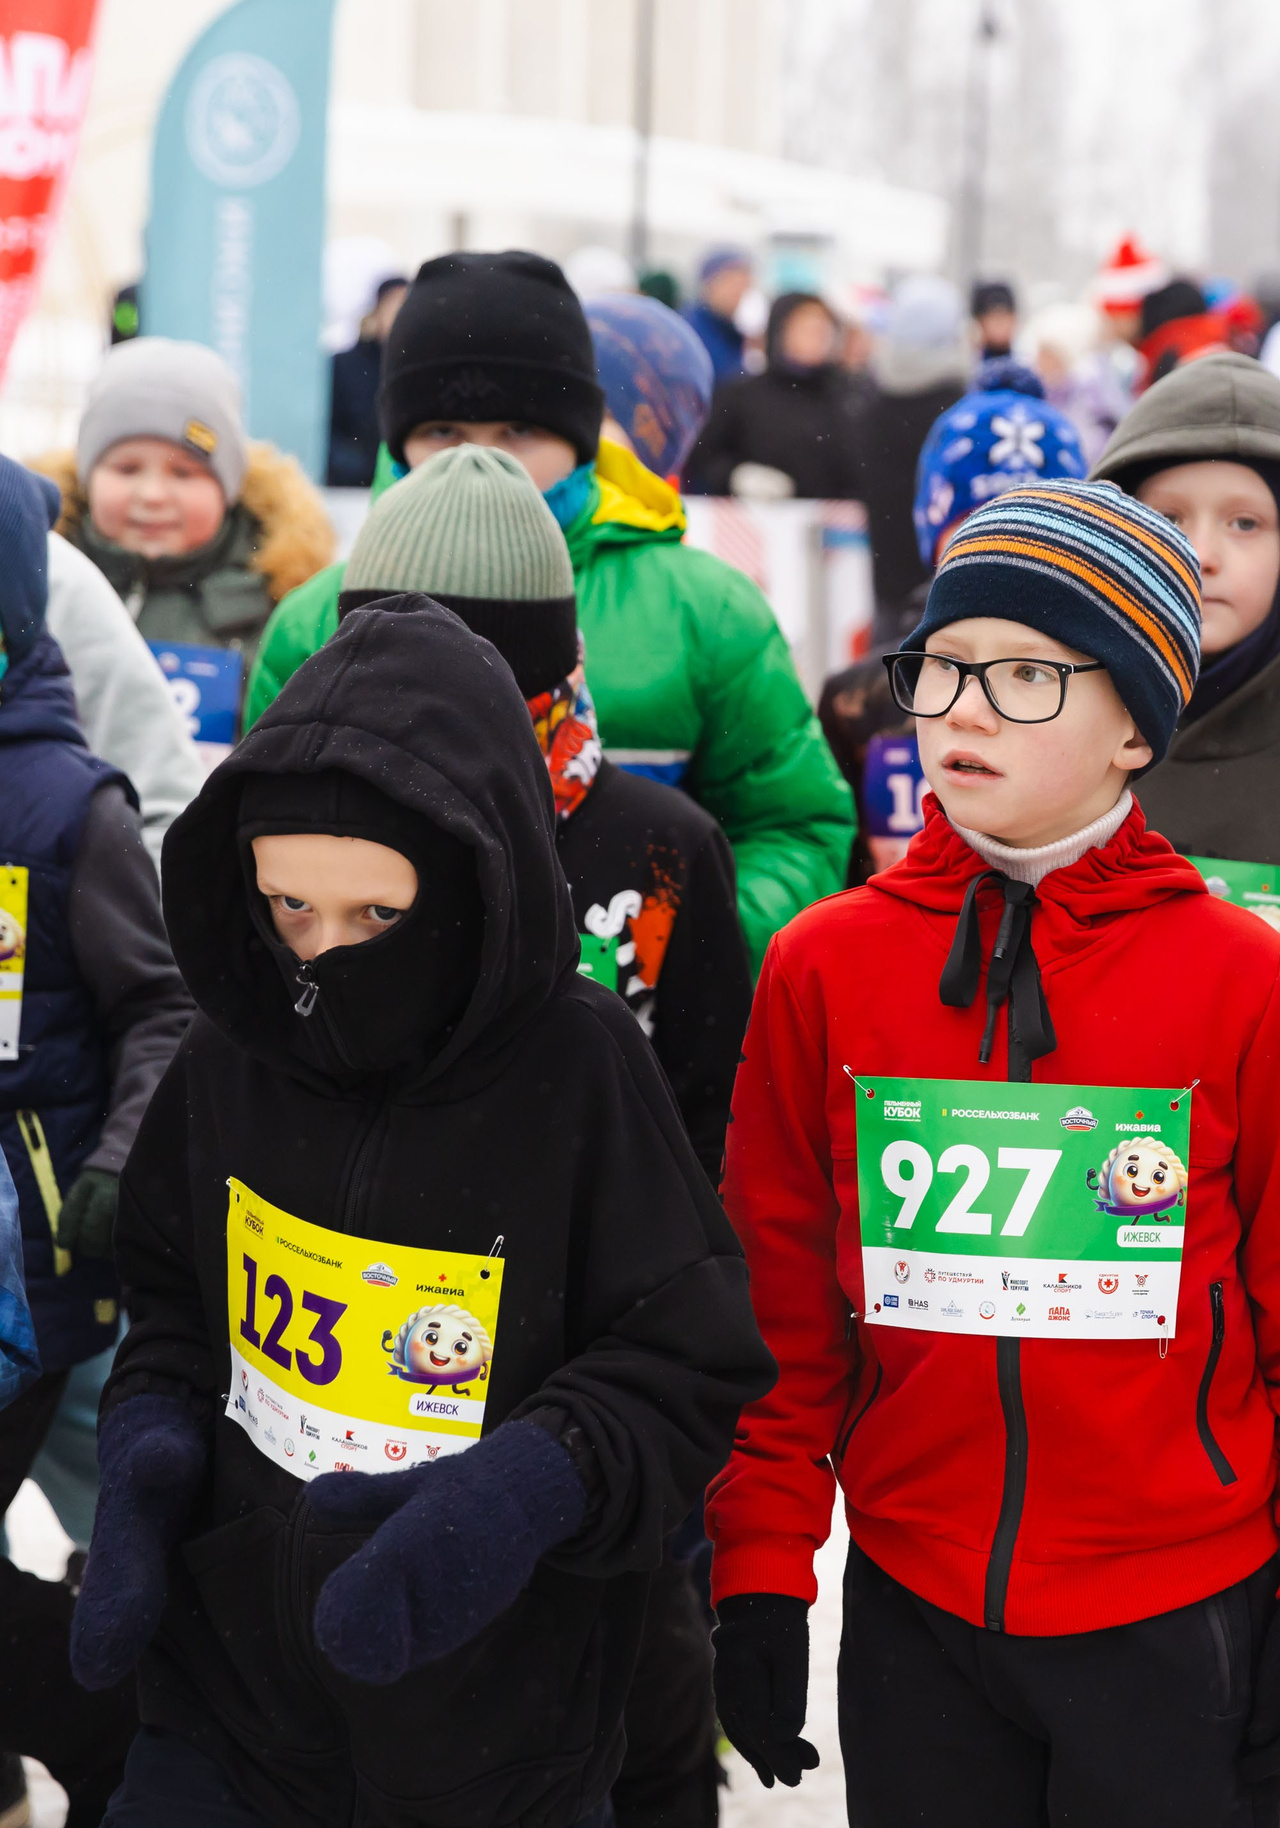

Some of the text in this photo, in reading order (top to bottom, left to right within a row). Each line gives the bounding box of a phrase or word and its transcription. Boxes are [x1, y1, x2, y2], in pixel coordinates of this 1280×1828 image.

[884, 1106, 921, 1118] КУБОК
[951, 1108, 1040, 1121] РОССЕЛЬХОЗБАНК
[1115, 1123, 1161, 1133] ижавиа
[880, 1139, 1063, 1237] 927
[245, 1214, 264, 1236] КУБОК
[1123, 1231, 1161, 1243] ИЖЕВСК
[279, 1237, 343, 1270] РОССЕЛЬХОЗБАНК
[362, 1272, 398, 1285] ВОСТОЧНЫЙ
[415, 1282, 465, 1297] ижавиа
[914, 1298, 929, 1308] HAS
[1048, 1306, 1070, 1316] ПАПА
[240, 1252, 348, 1385] 123
[416, 1399, 459, 1416] ИЖЕВСК
[332, 1436, 368, 1450] КАЛАШНИКОВ
